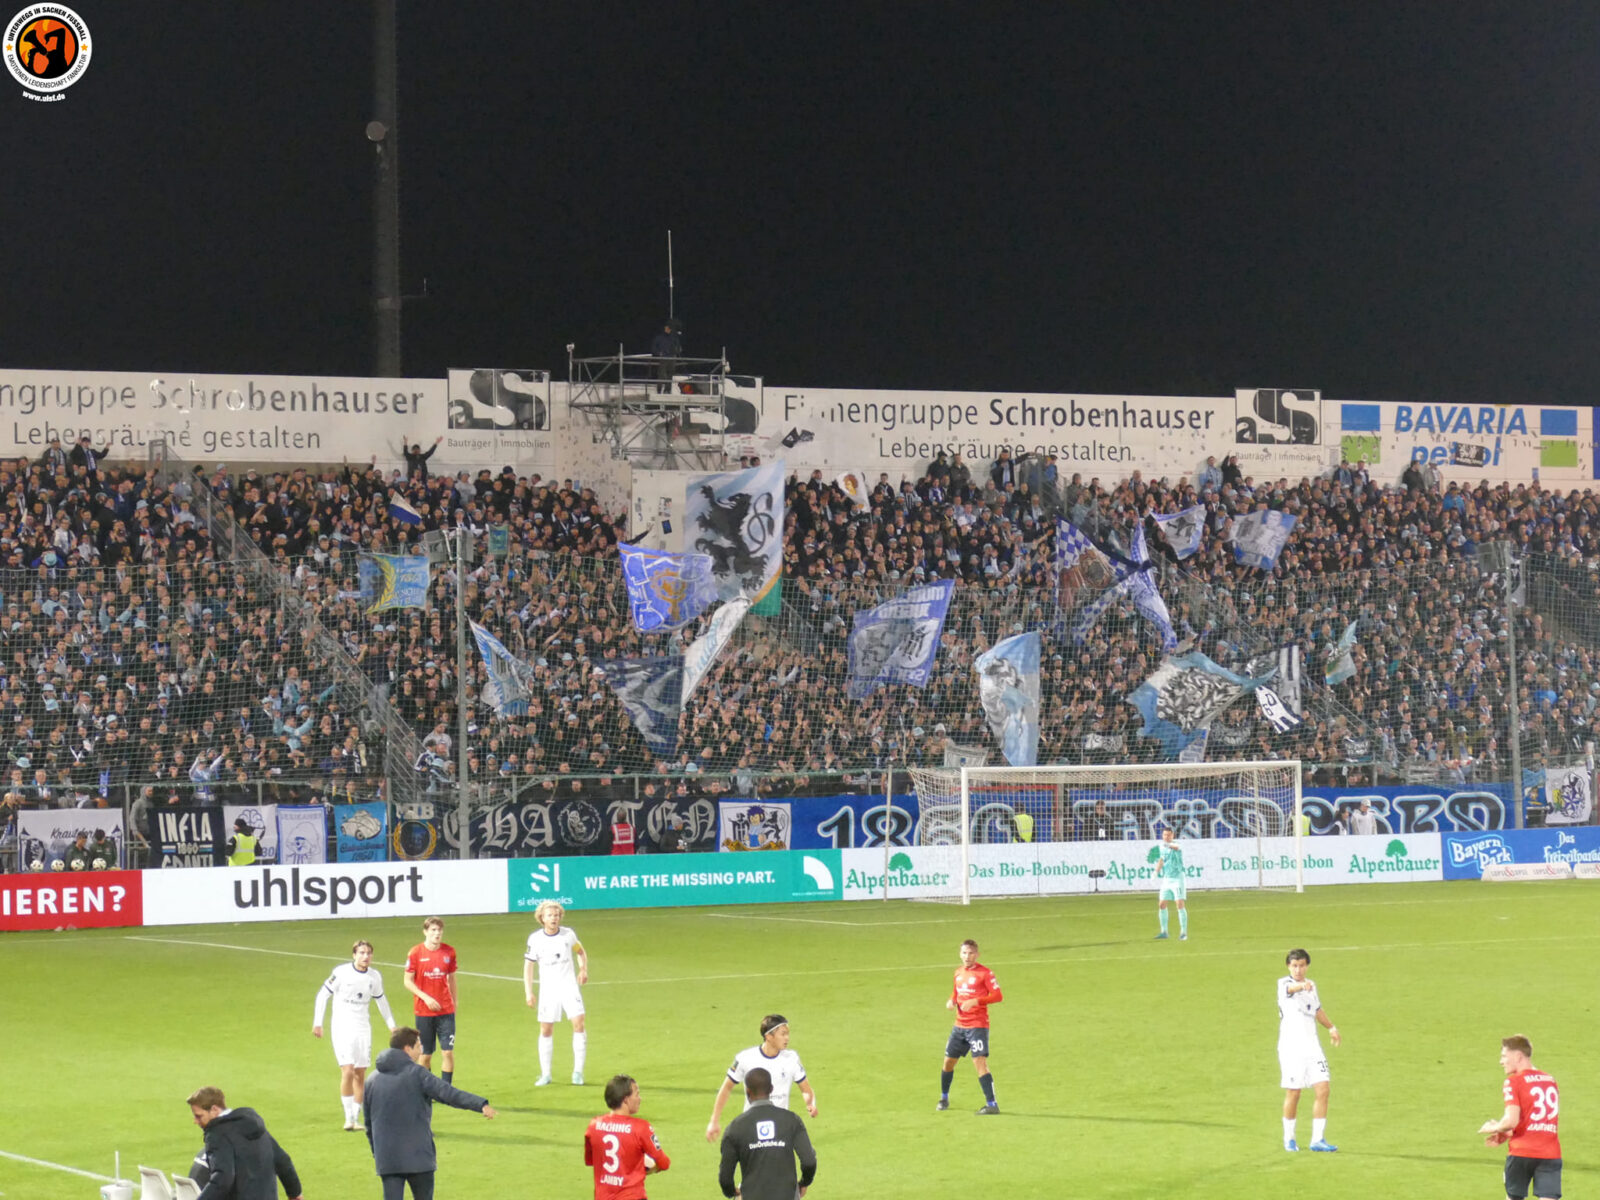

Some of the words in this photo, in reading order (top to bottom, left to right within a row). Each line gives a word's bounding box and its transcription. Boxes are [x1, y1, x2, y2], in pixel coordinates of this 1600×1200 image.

[149, 379, 424, 415] Schrobenhauser
[989, 398, 1215, 429] Schrobenhauser
[1395, 405, 1528, 435] BAVARIA
[204, 425, 321, 453] gestalten
[447, 438, 491, 449] Bauträger
[501, 438, 550, 448] Immobilien
[1034, 439, 1132, 464] gestalten
[158, 812, 213, 842] INFLA
[1556, 831, 1575, 848] Das
[1221, 856, 1246, 872] Das
[1451, 838, 1502, 864] Bayern
[1478, 847, 1512, 870] Park
[968, 863, 994, 878] Das
[999, 860, 1088, 877] Bio-Bonbon
[1348, 852, 1440, 879] Alpenbauer
[234, 867, 423, 914] uhlsport
[584, 876, 608, 889] WE
[610, 875, 639, 888] ARE
[641, 874, 669, 887] THE
[672, 872, 734, 887] MISSING
[737, 870, 775, 884] PART.
[845, 867, 949, 894] Alpenbauer
[3, 885, 126, 916] IEREN?
[971, 1039, 984, 1053] 30
[1529, 1086, 1559, 1121] 39
[595, 1121, 632, 1134] HACHING
[602, 1134, 619, 1173] 3
